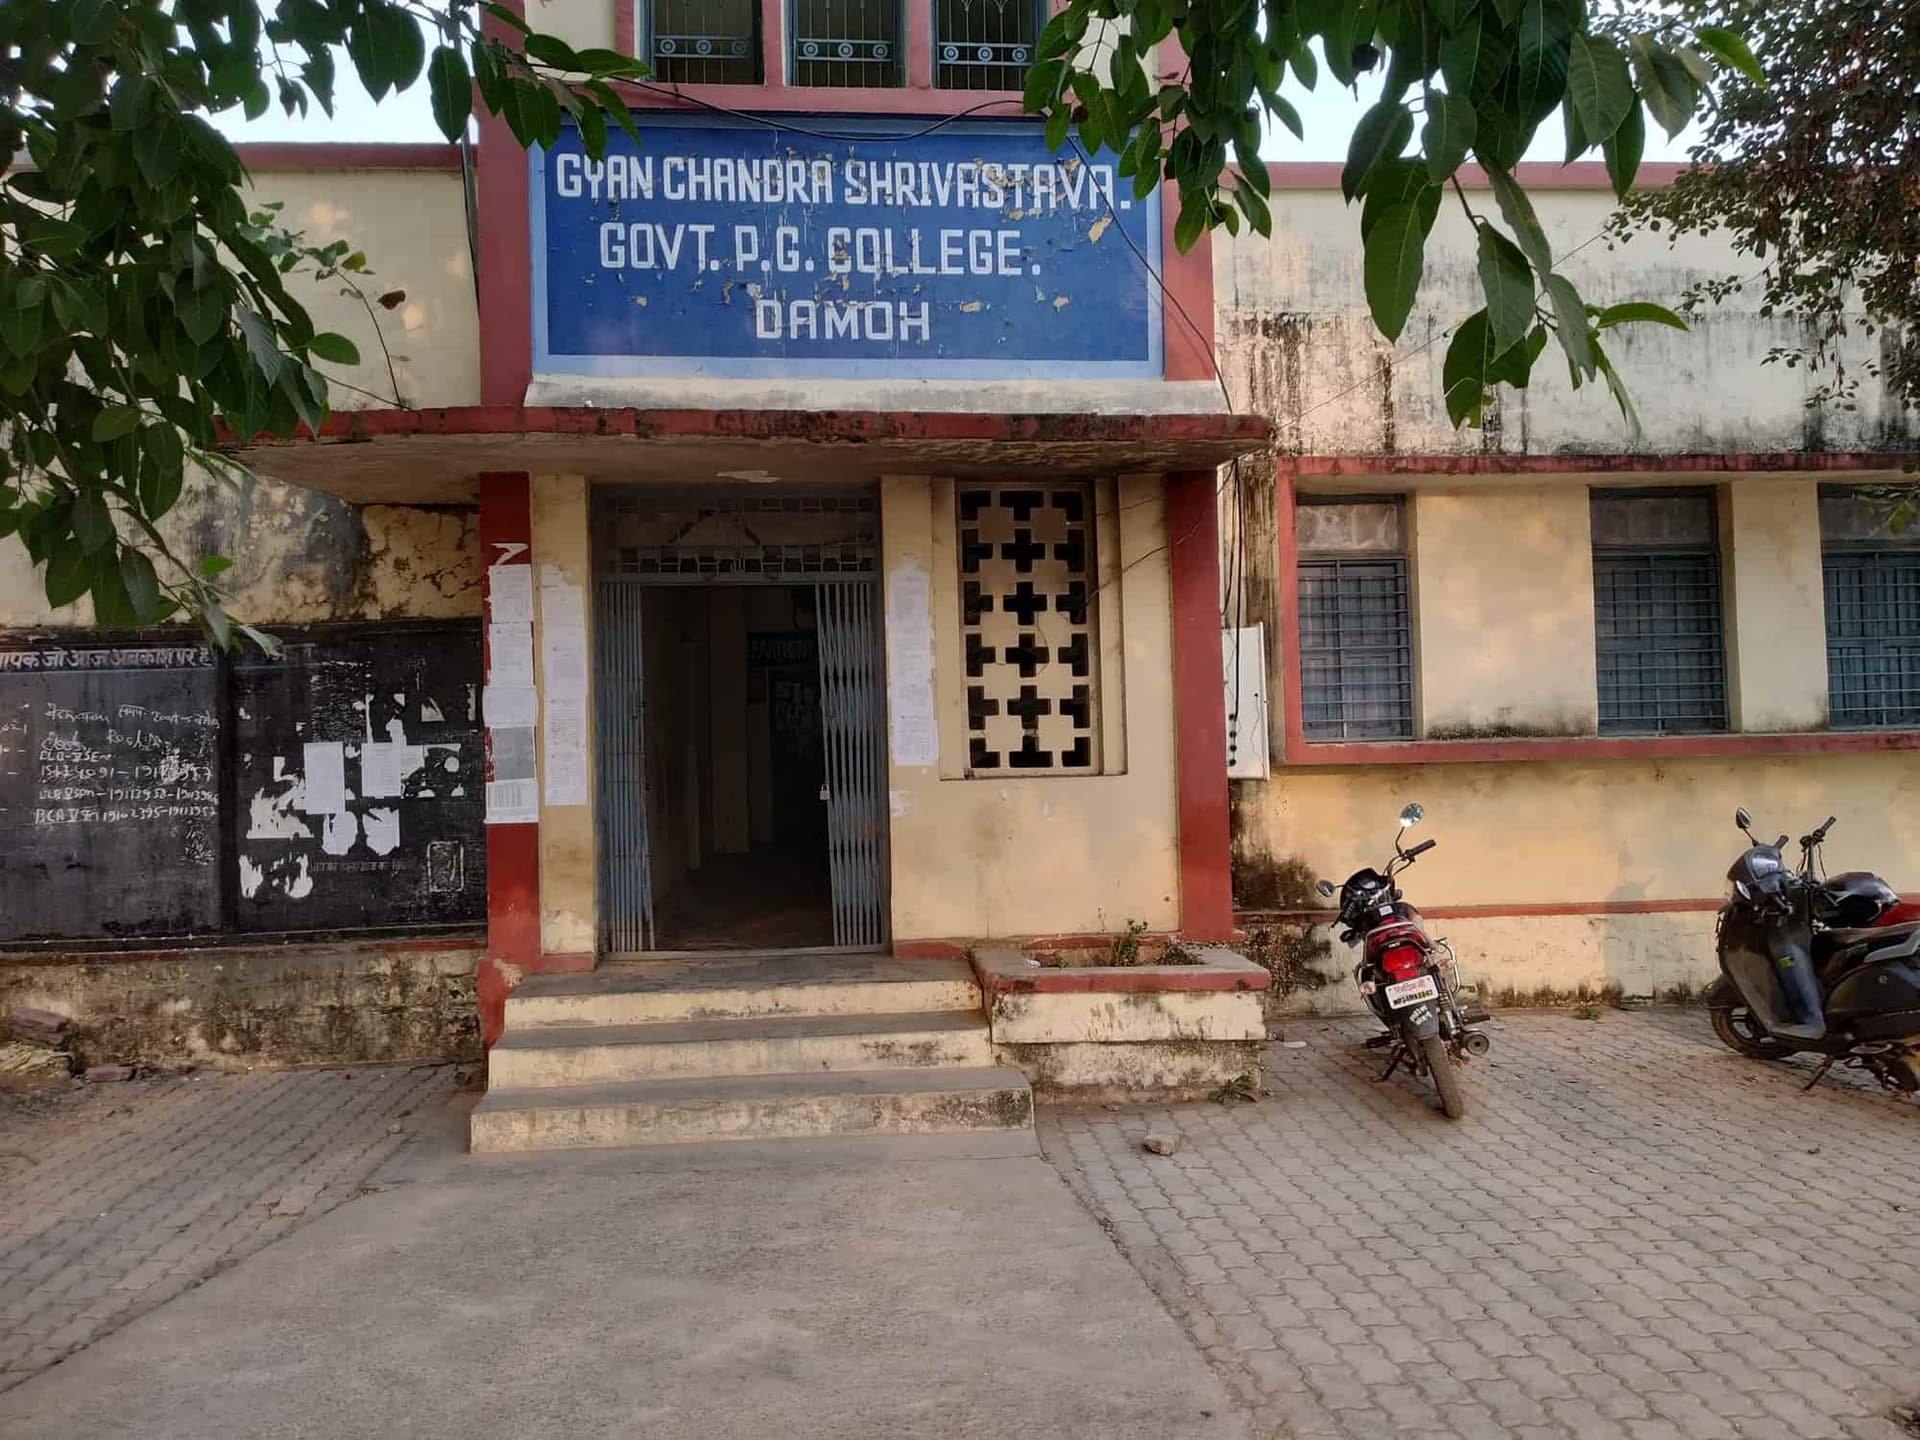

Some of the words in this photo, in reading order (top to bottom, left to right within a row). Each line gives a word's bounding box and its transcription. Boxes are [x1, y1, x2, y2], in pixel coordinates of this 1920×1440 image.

[556, 153, 653, 200] GYAN
[663, 155, 833, 204] CHANDRA
[844, 160, 1132, 210] SHRIVASTAVA.
[600, 222, 721, 272] GOVT.
[735, 225, 815, 273] P.G.
[827, 226, 1042, 276] COLLEGE.
[755, 299, 930, 341] DAMOH
